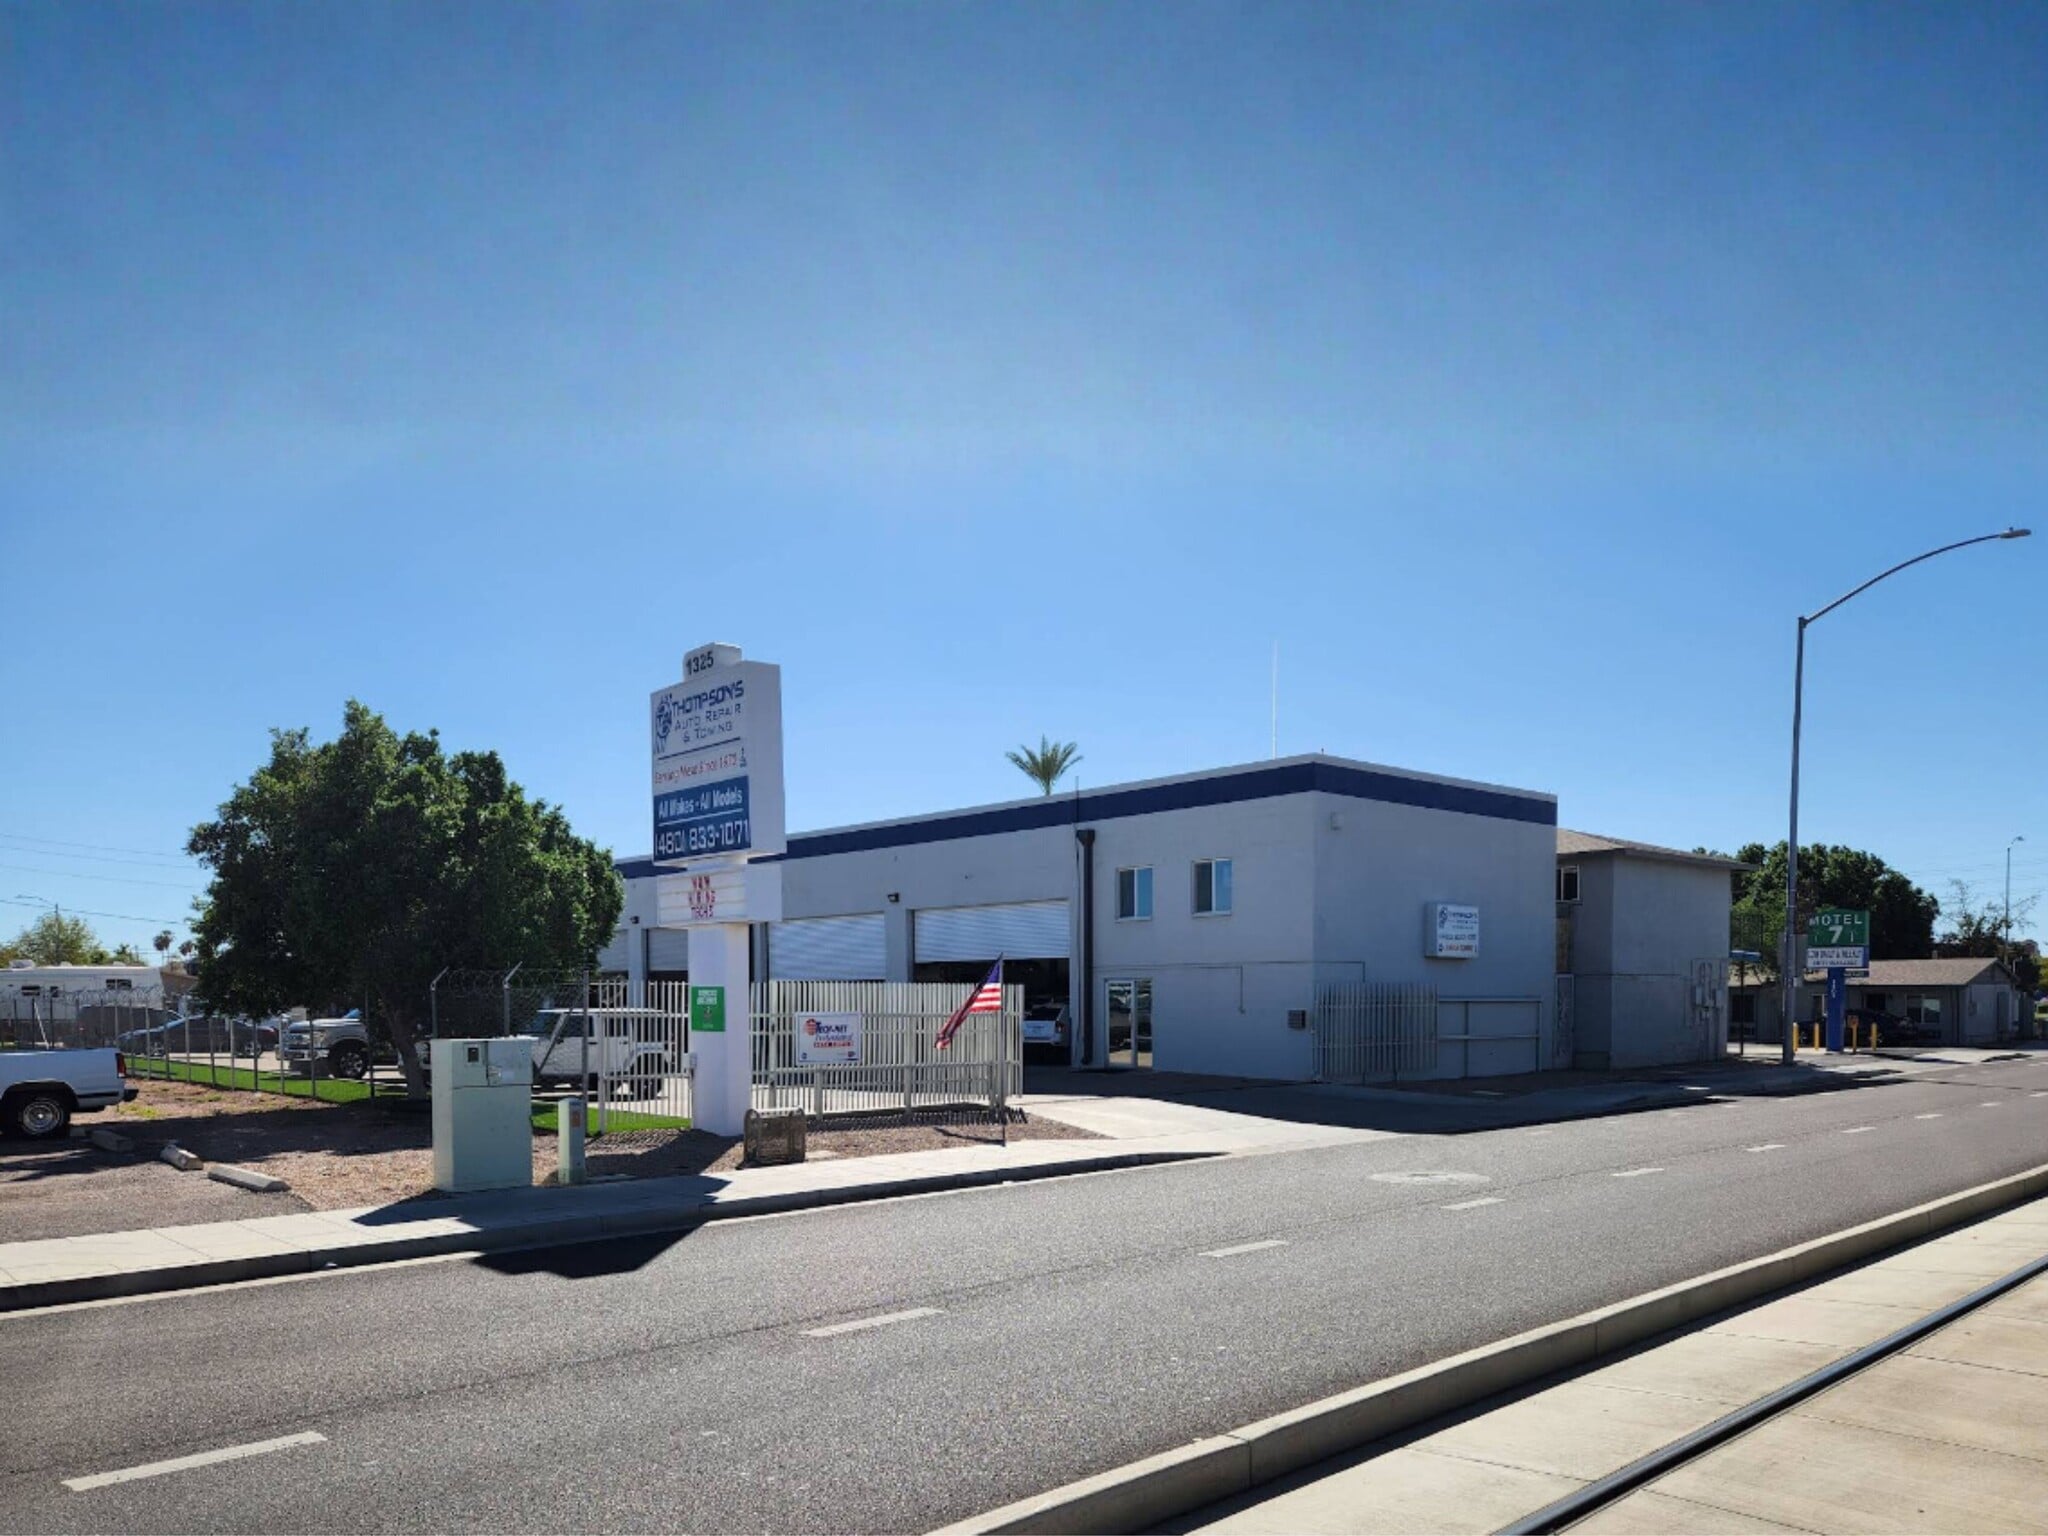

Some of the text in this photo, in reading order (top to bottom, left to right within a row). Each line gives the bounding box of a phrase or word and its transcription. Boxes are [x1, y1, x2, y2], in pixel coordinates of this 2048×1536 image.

[685, 651, 714, 675] 1325
[674, 703, 741, 731] AUTO REPAIR
[694, 721, 732, 739] TOWNG
[659, 800, 668, 818] All
[701, 792, 711, 811] All
[713, 787, 742, 806] Models
[689, 819, 749, 850] 833-1071
[1809, 914, 1862, 926] MOTEL
[1829, 925, 1843, 943] 7
